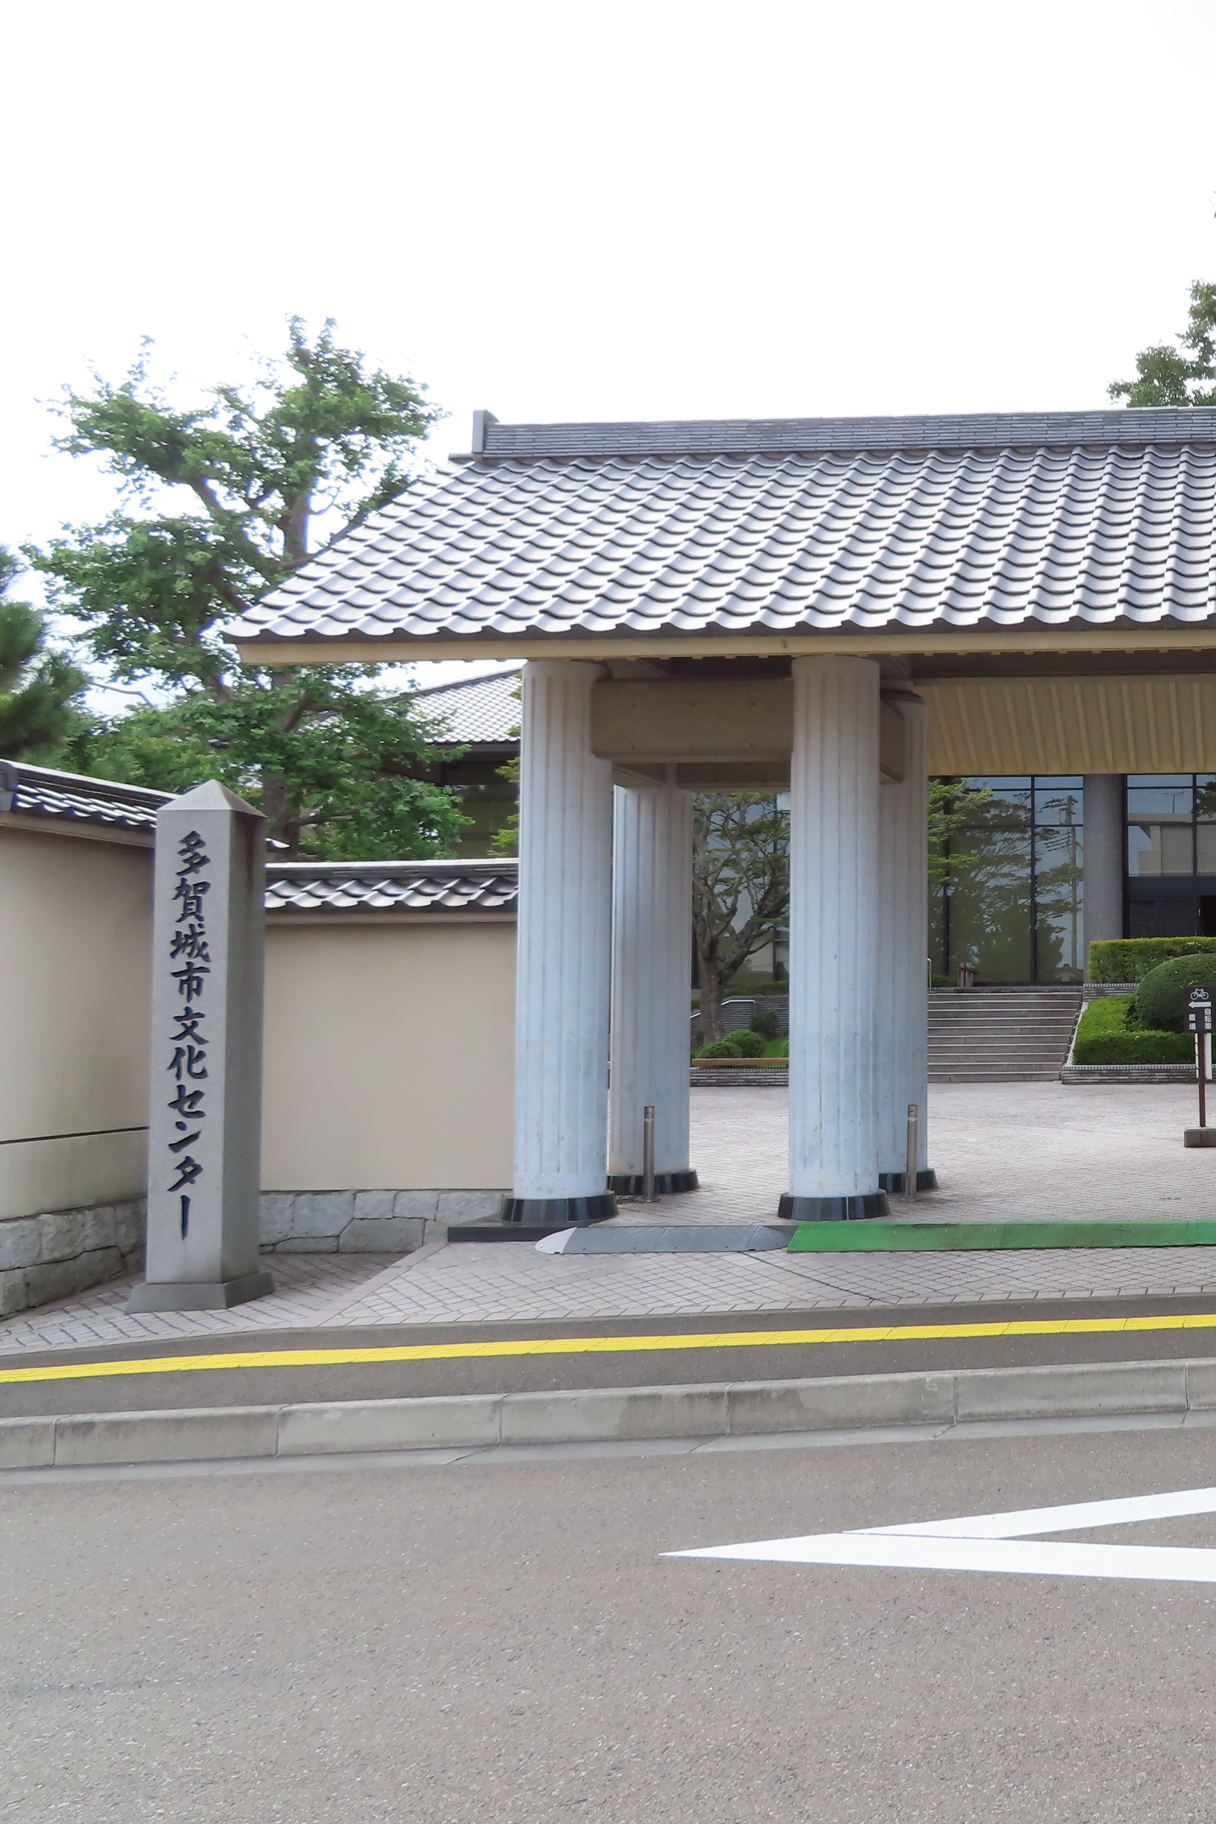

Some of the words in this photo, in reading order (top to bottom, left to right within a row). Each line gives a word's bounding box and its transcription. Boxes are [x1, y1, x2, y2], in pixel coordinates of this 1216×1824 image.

[167, 830, 212, 1241] 多賀城市文化センター
